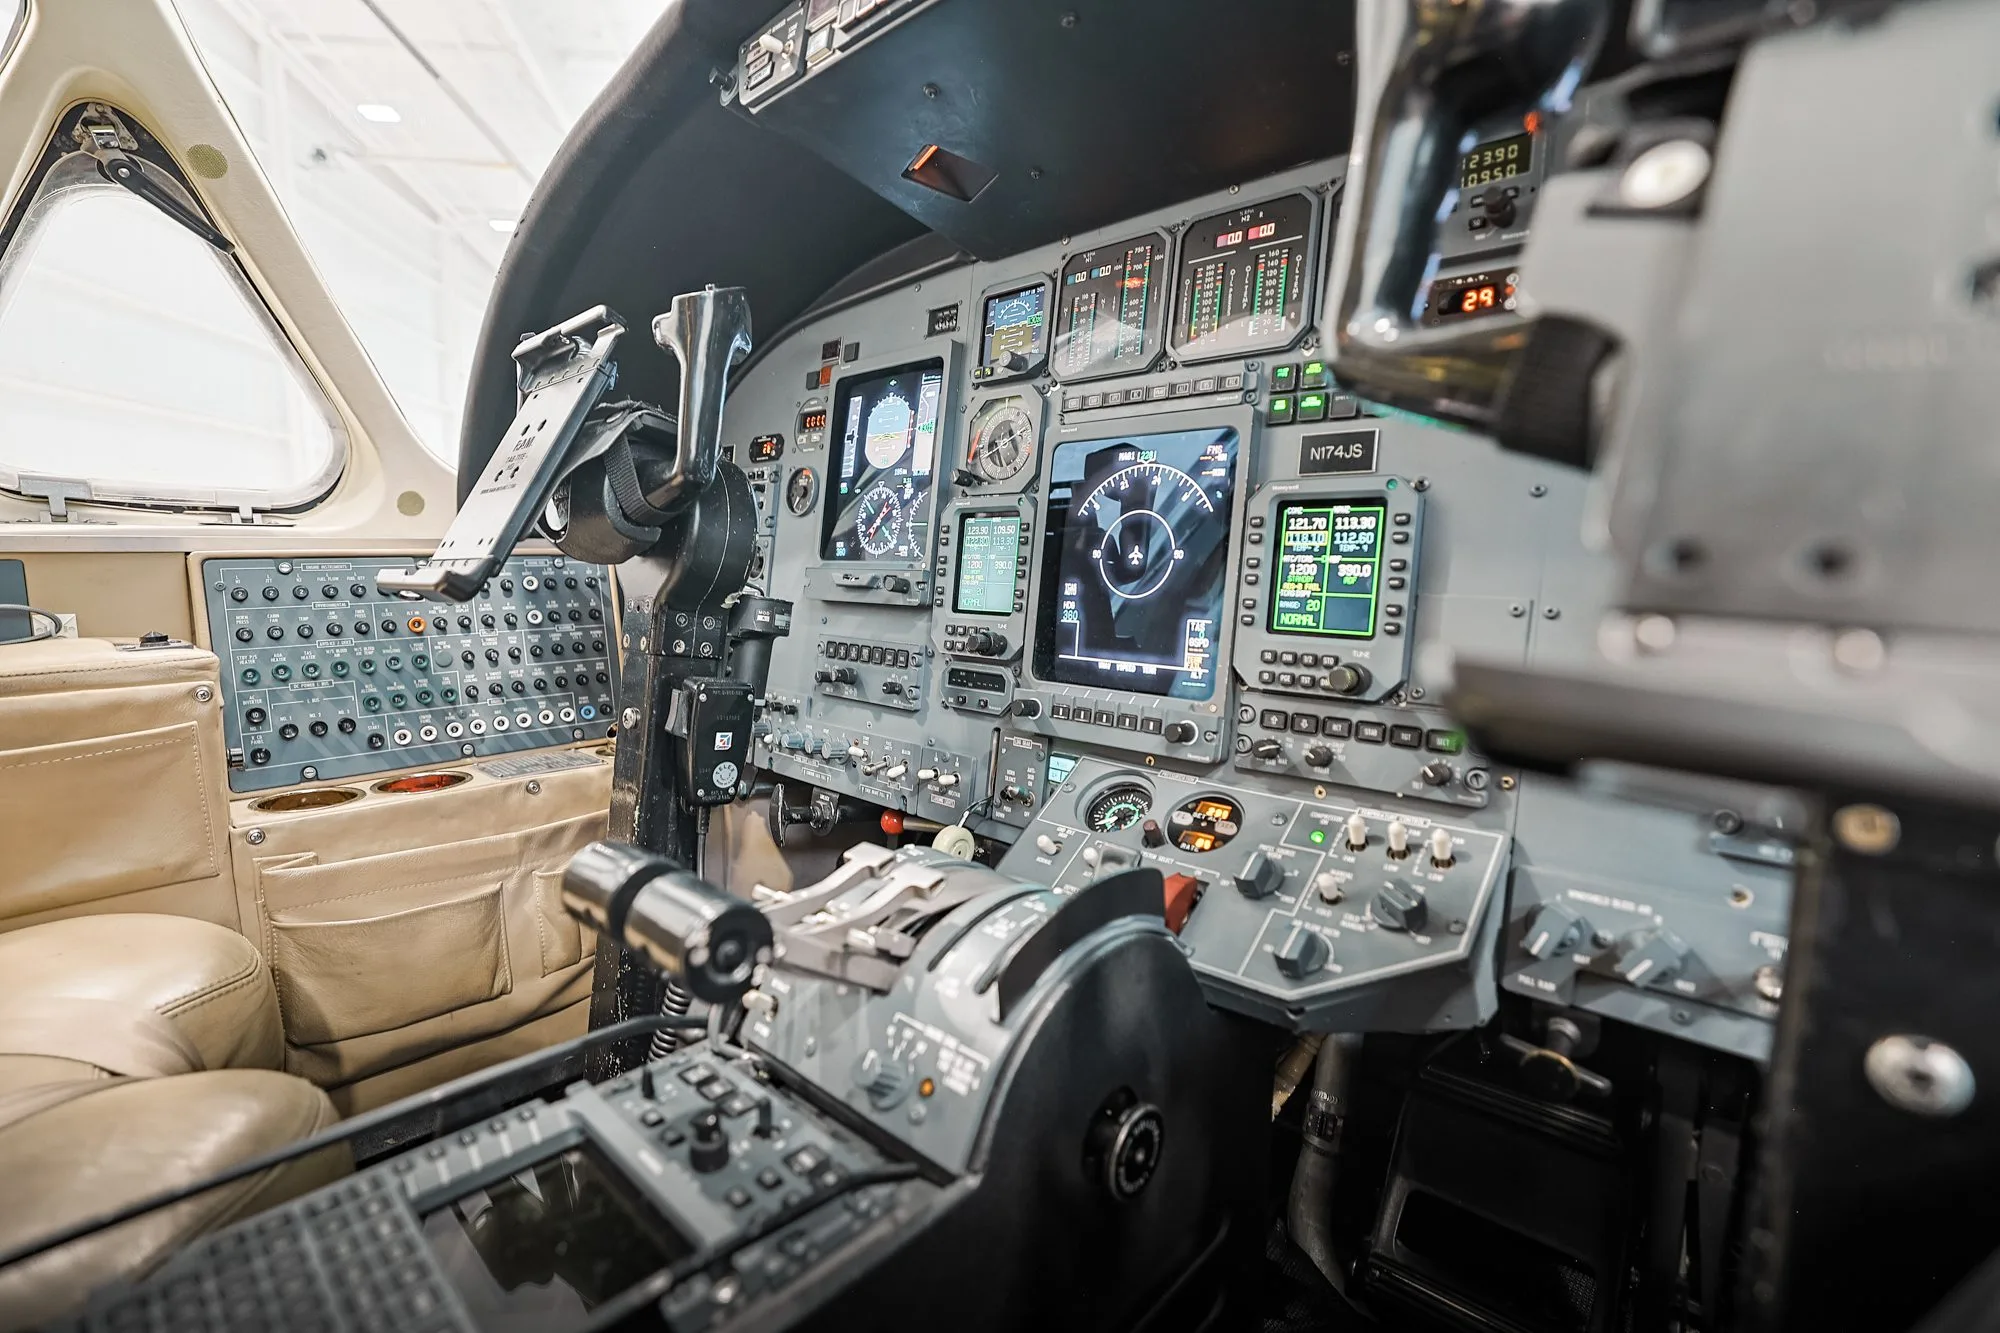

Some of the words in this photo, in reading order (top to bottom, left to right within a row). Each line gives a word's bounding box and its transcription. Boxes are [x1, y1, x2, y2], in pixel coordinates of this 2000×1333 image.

[1269, 249, 1280, 257] 160
[1132, 263, 1143, 271] 700
[1268, 259, 1279, 267] 140
[1462, 286, 1495, 313] 29
[1310, 443, 1363, 461] N174JS
[1289, 518, 1327, 530] 121.70
[1334, 532, 1375, 544] 112.60
[1289, 563, 1317, 575] 1200
[1305, 600, 1320, 611] 20
[1280, 613, 1316, 626] NORMAL
[1180, 842, 1199, 852] RATE
